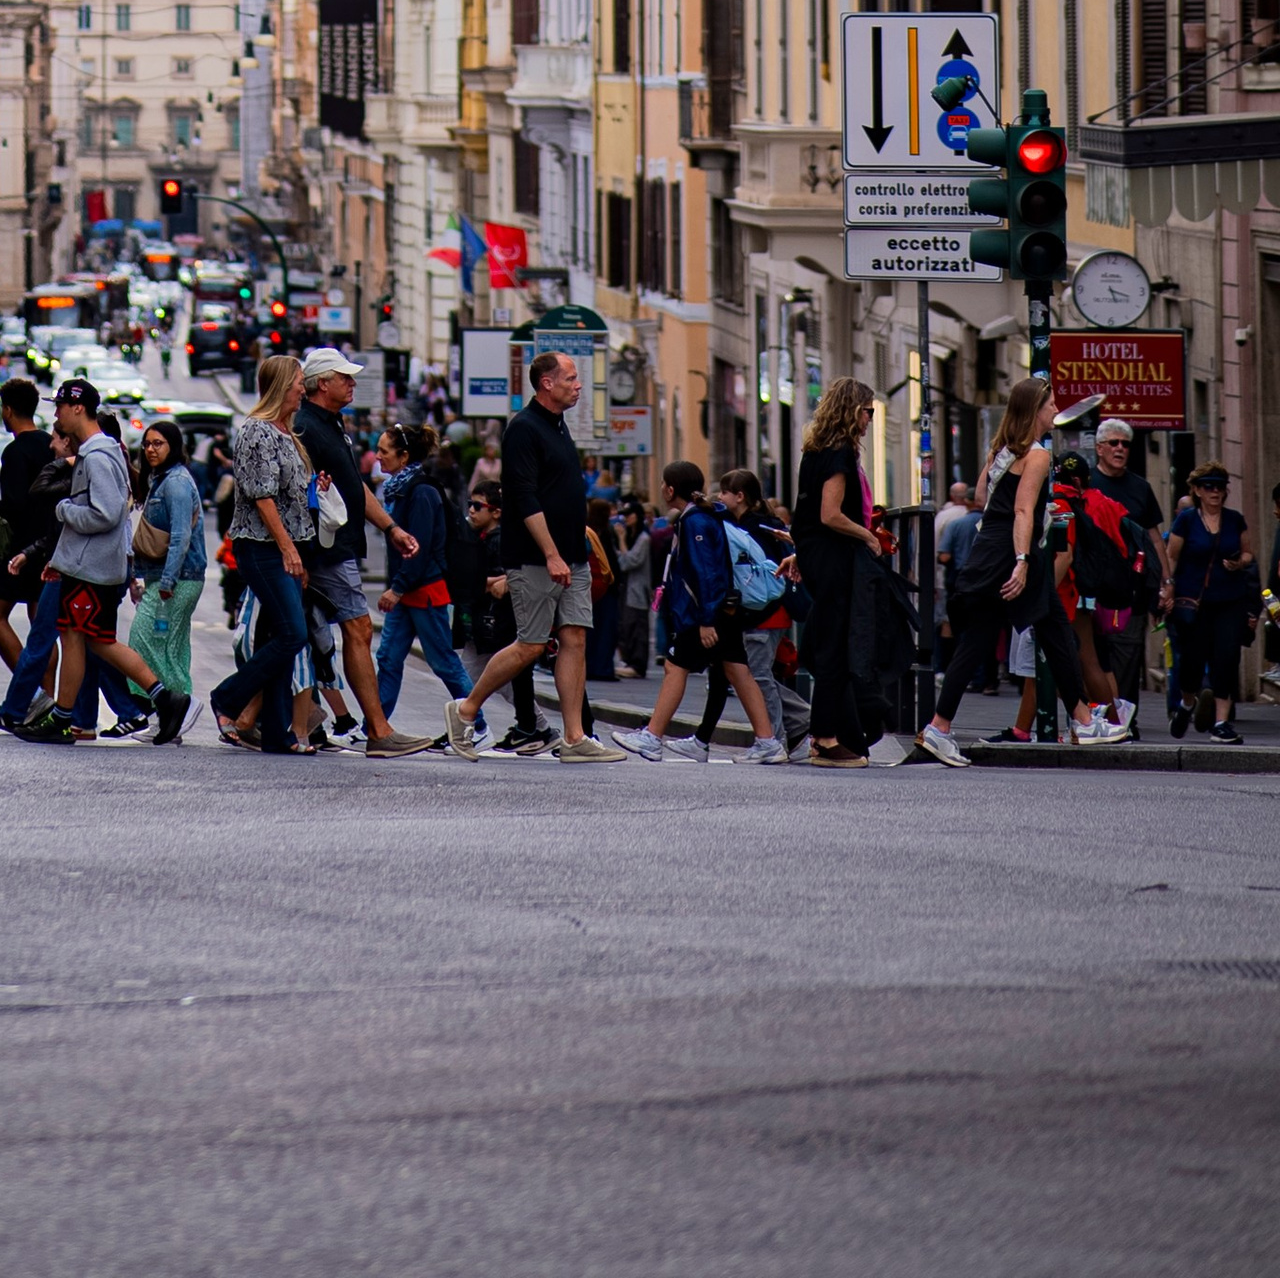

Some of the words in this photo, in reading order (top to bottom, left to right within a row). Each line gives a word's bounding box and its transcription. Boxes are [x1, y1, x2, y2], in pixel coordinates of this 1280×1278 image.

[854, 183, 915, 196] controllo
[859, 202, 897, 216] corsia
[904, 202, 986, 217] preferenzi
[887, 237, 961, 252] eccetto
[871, 257, 975, 273] autorizzati
[1106, 255, 1118, 265] 12
[1077, 285, 1084, 294] 9
[1139, 287, 1145, 296] 3
[1107, 316, 1114, 326] 6
[1082, 342, 1144, 360] HOTEL
[1056, 361, 1172, 382] STENDHAL
[1057, 385, 1068, 395] &
[1070, 384, 1120, 396] LUXURY
[1125, 384, 1173, 396] SUITES
